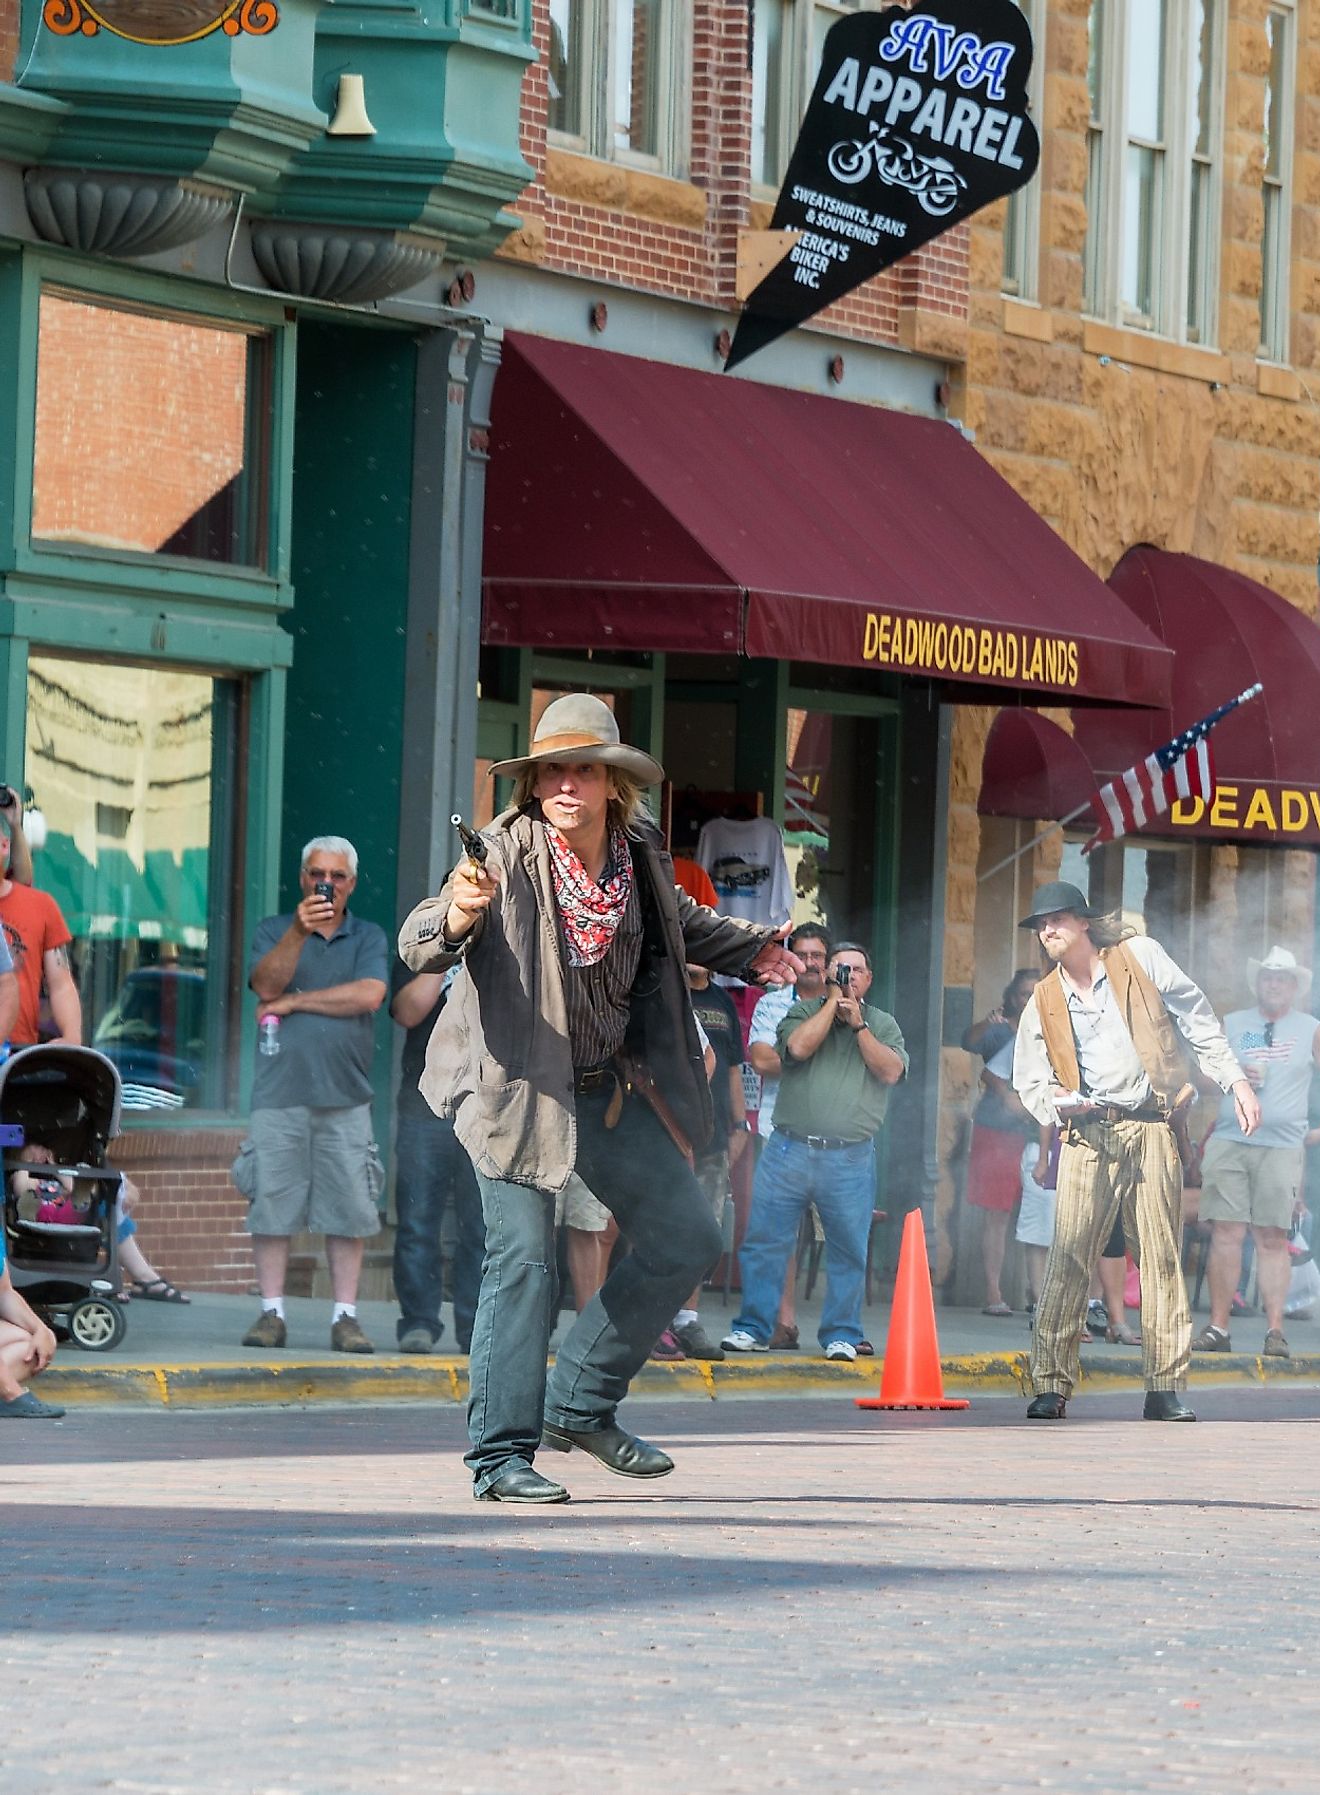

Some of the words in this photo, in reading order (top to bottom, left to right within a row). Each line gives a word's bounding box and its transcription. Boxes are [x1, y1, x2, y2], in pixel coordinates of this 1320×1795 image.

[879, 14, 1016, 101] AVA
[823, 57, 1025, 170] APPAREL
[791, 184, 870, 227] SWEATSHIRTS,
[870, 213, 907, 238] JEANS
[805, 207, 817, 225] &
[815, 211, 881, 247] SOUVENIRS
[789, 246, 830, 274] BIKER
[793, 265, 820, 290] INC.
[863, 613, 977, 674] DEADWOOD
[977, 629, 1019, 679] BAD
[1021, 635, 1079, 687] LANDS
